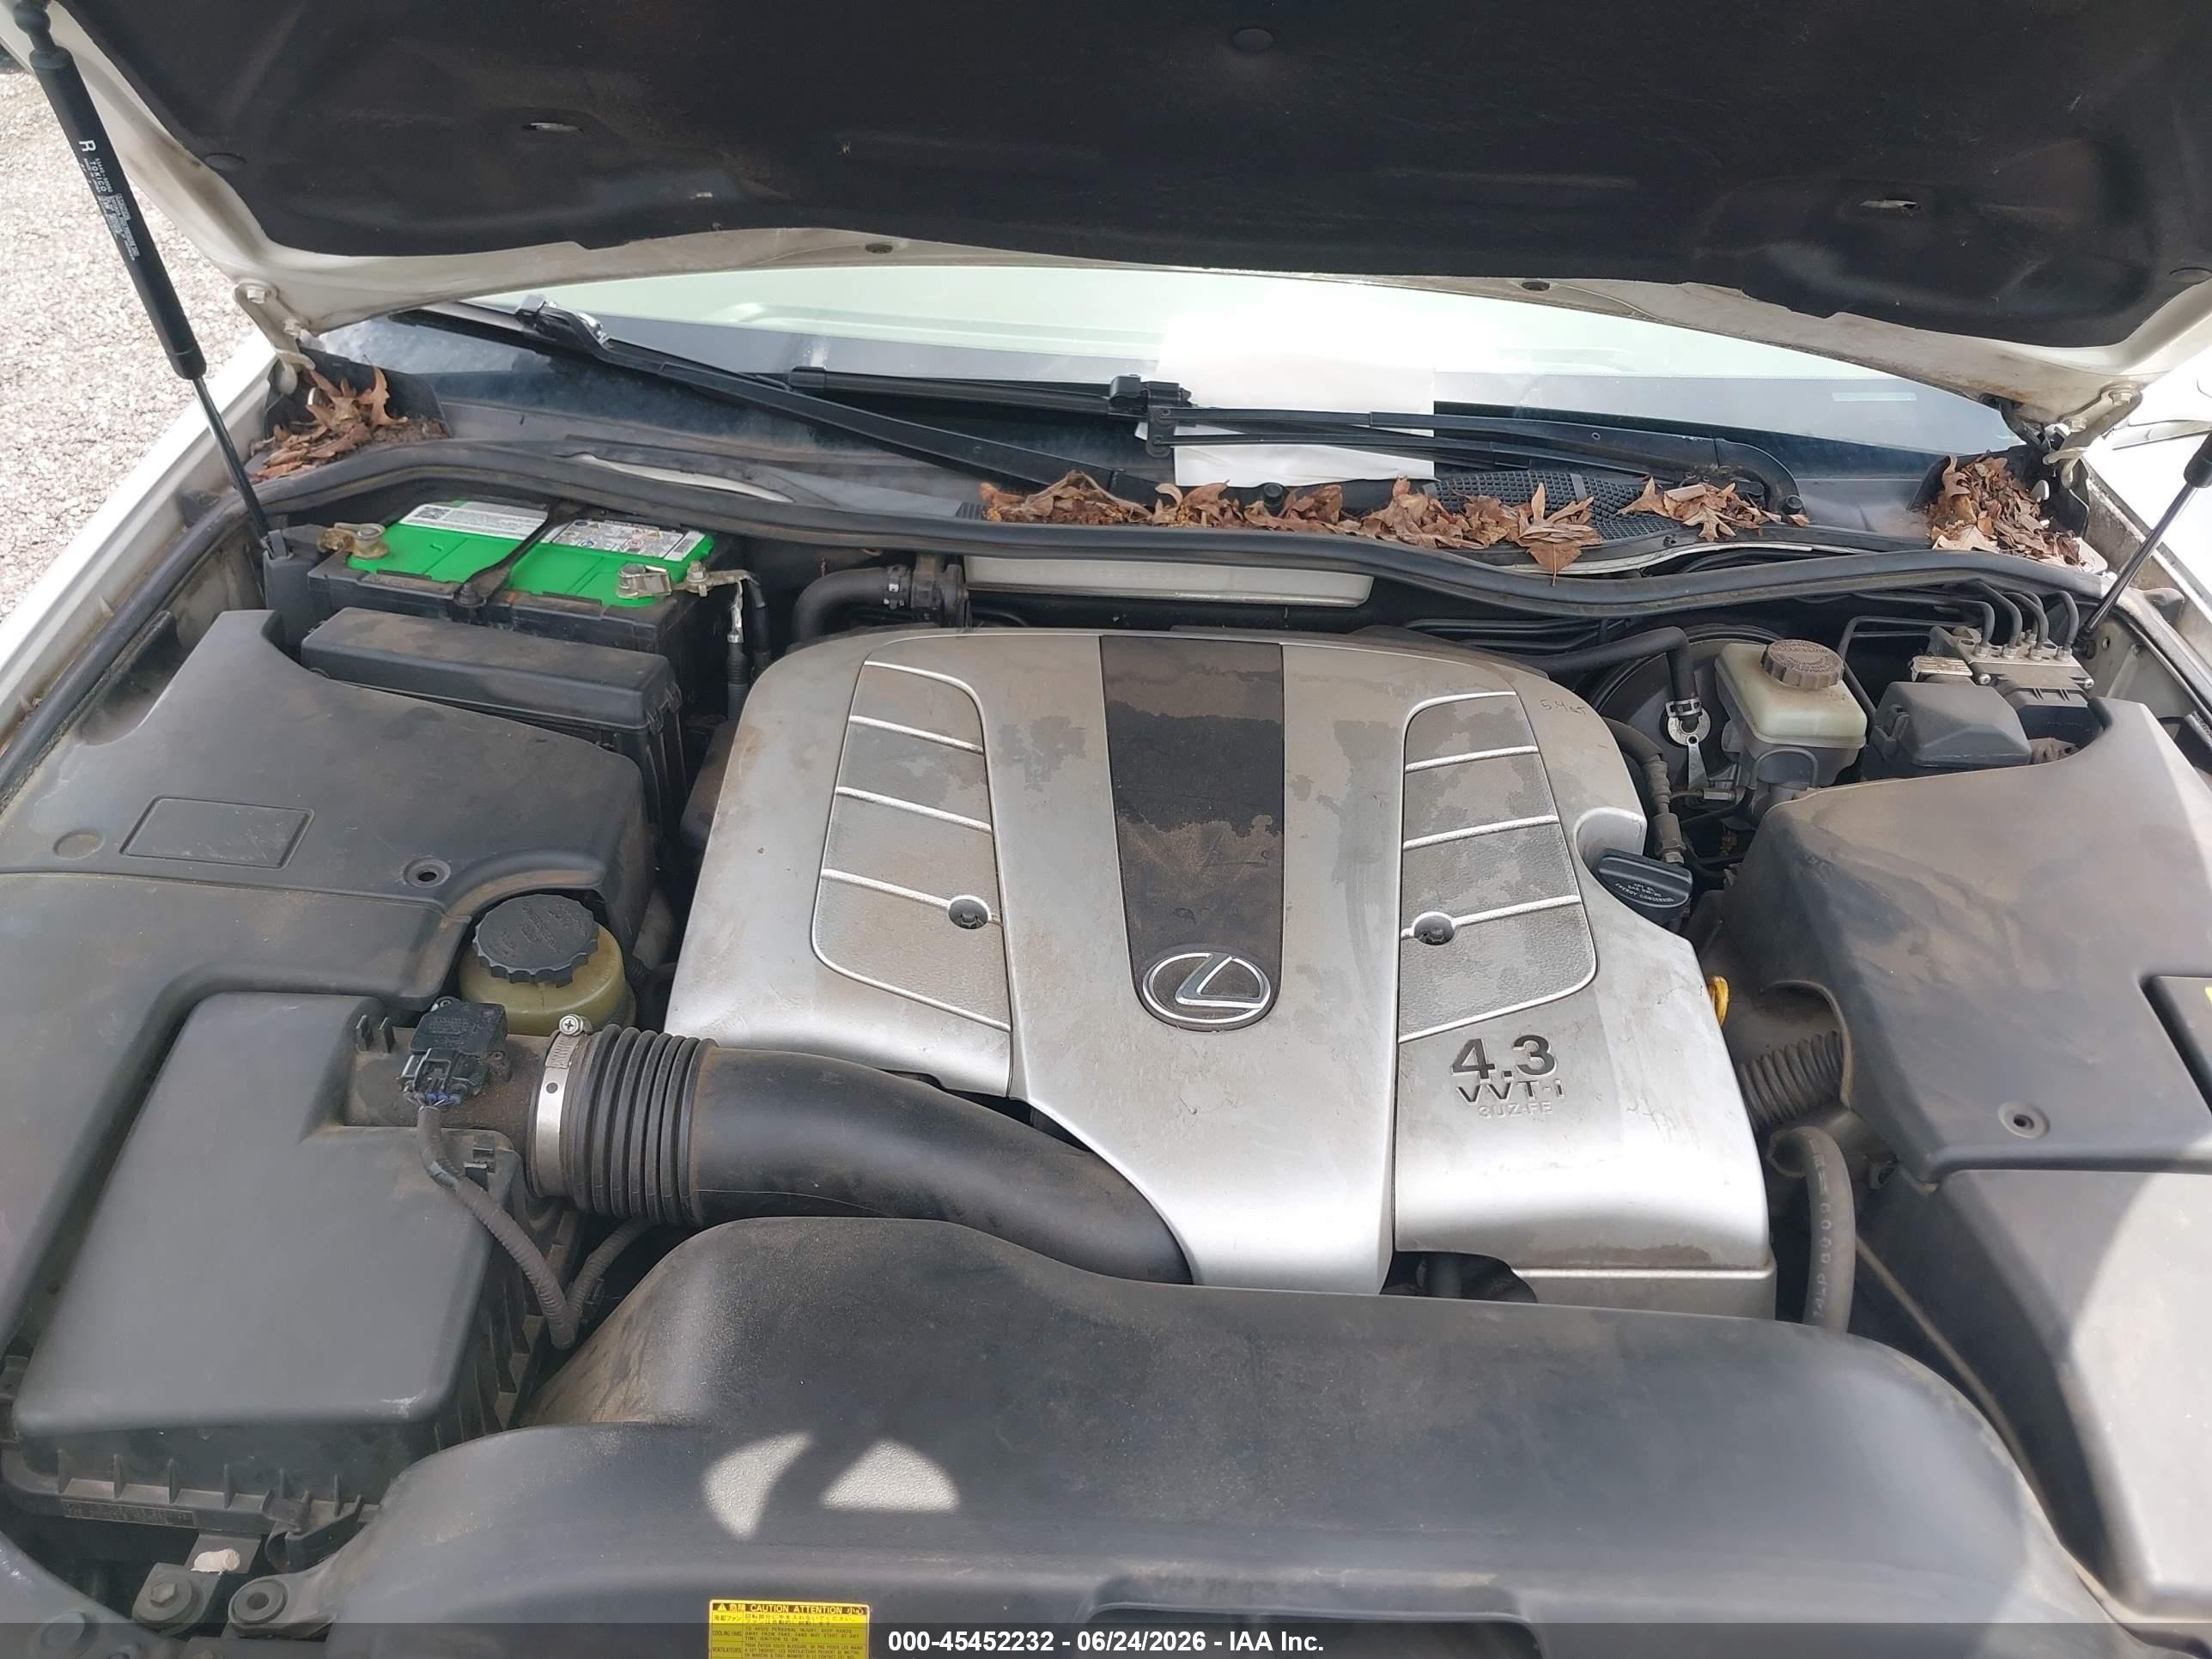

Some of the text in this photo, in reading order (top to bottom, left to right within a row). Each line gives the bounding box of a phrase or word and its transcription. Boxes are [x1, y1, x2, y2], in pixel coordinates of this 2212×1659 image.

[78, 140, 97, 152] R
[89, 161, 107, 191] TOKICO
[1451, 1034, 1558, 1081] 4.3
[750, 1604, 789, 1613] CAUTION
[793, 1605, 843, 1614] ATTENTION
